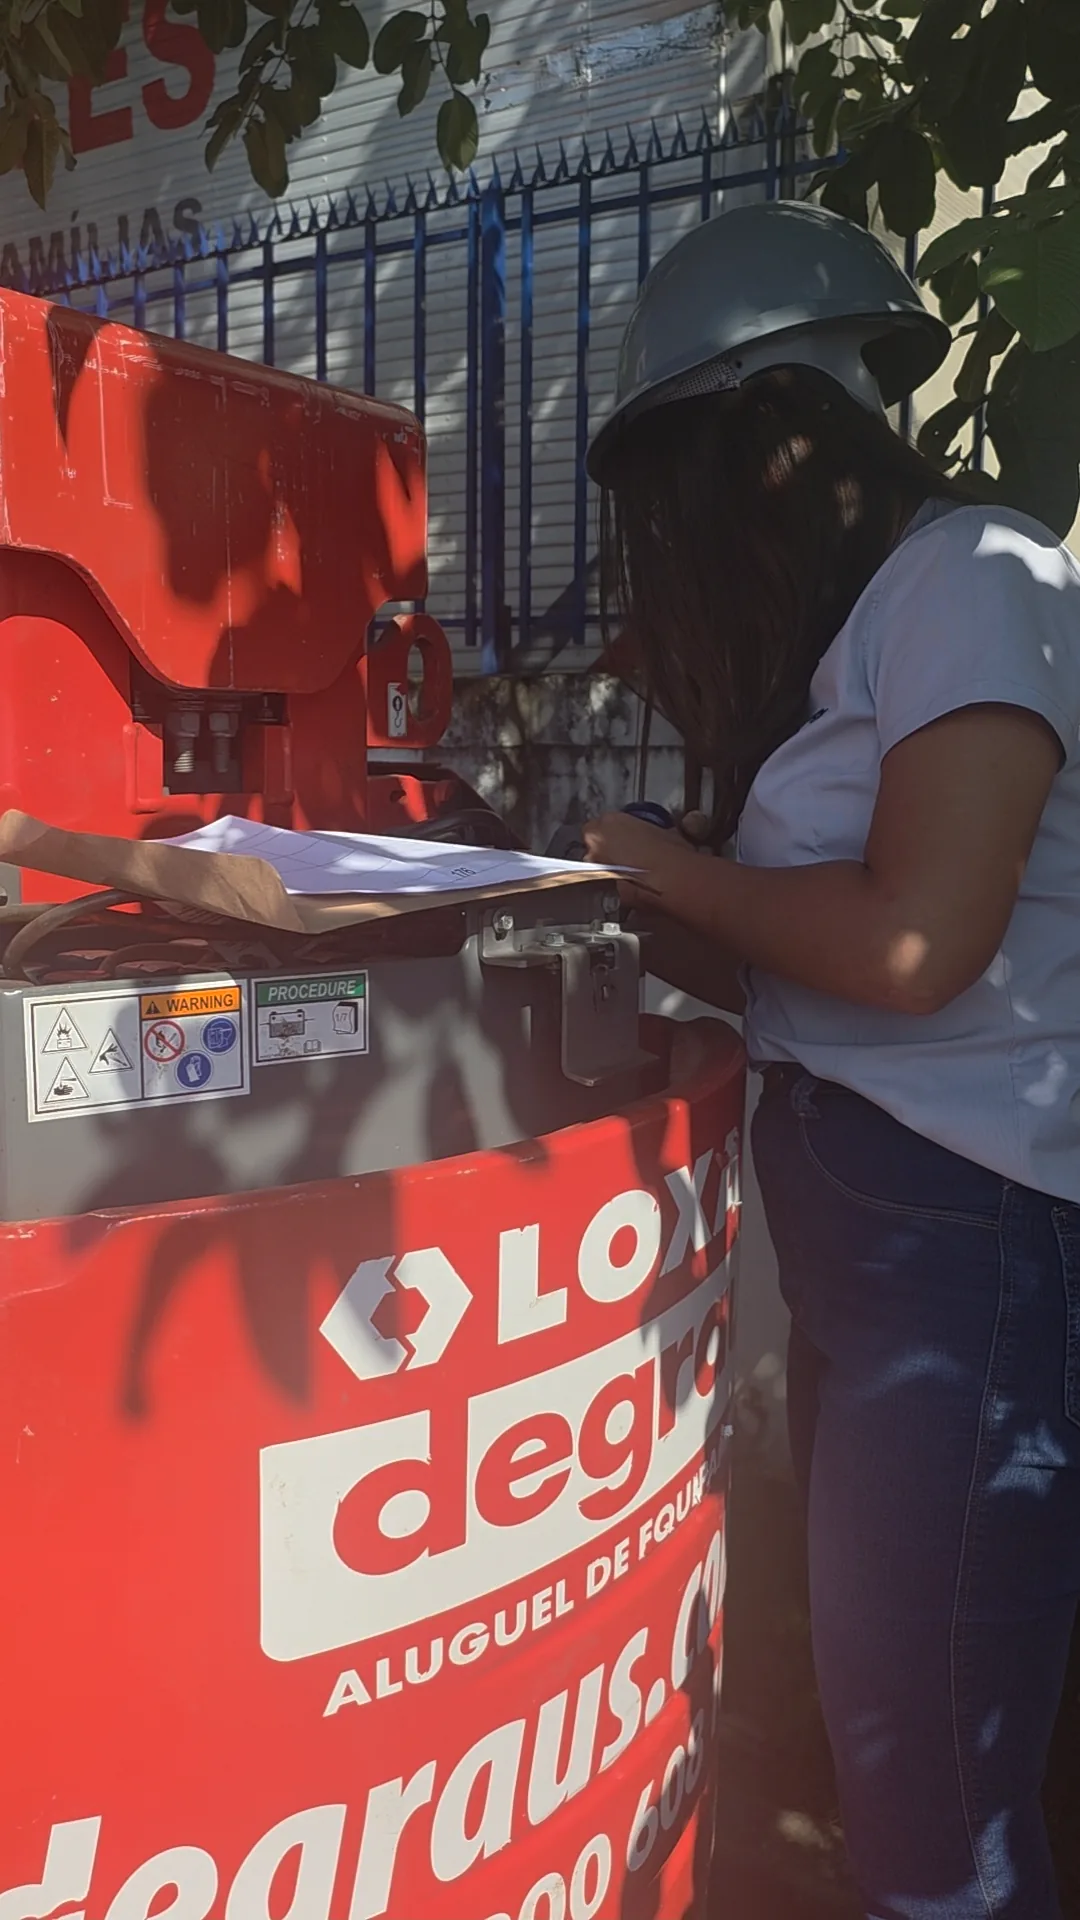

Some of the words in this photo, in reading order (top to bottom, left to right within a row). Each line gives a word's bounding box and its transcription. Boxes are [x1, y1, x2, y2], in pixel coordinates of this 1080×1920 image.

[267, 980, 357, 1002] PROCEDURE
[166, 993, 234, 1013] WARNING
[322, 1578, 576, 1717] ALUGUEL
[586, 1536, 631, 1599] DE
